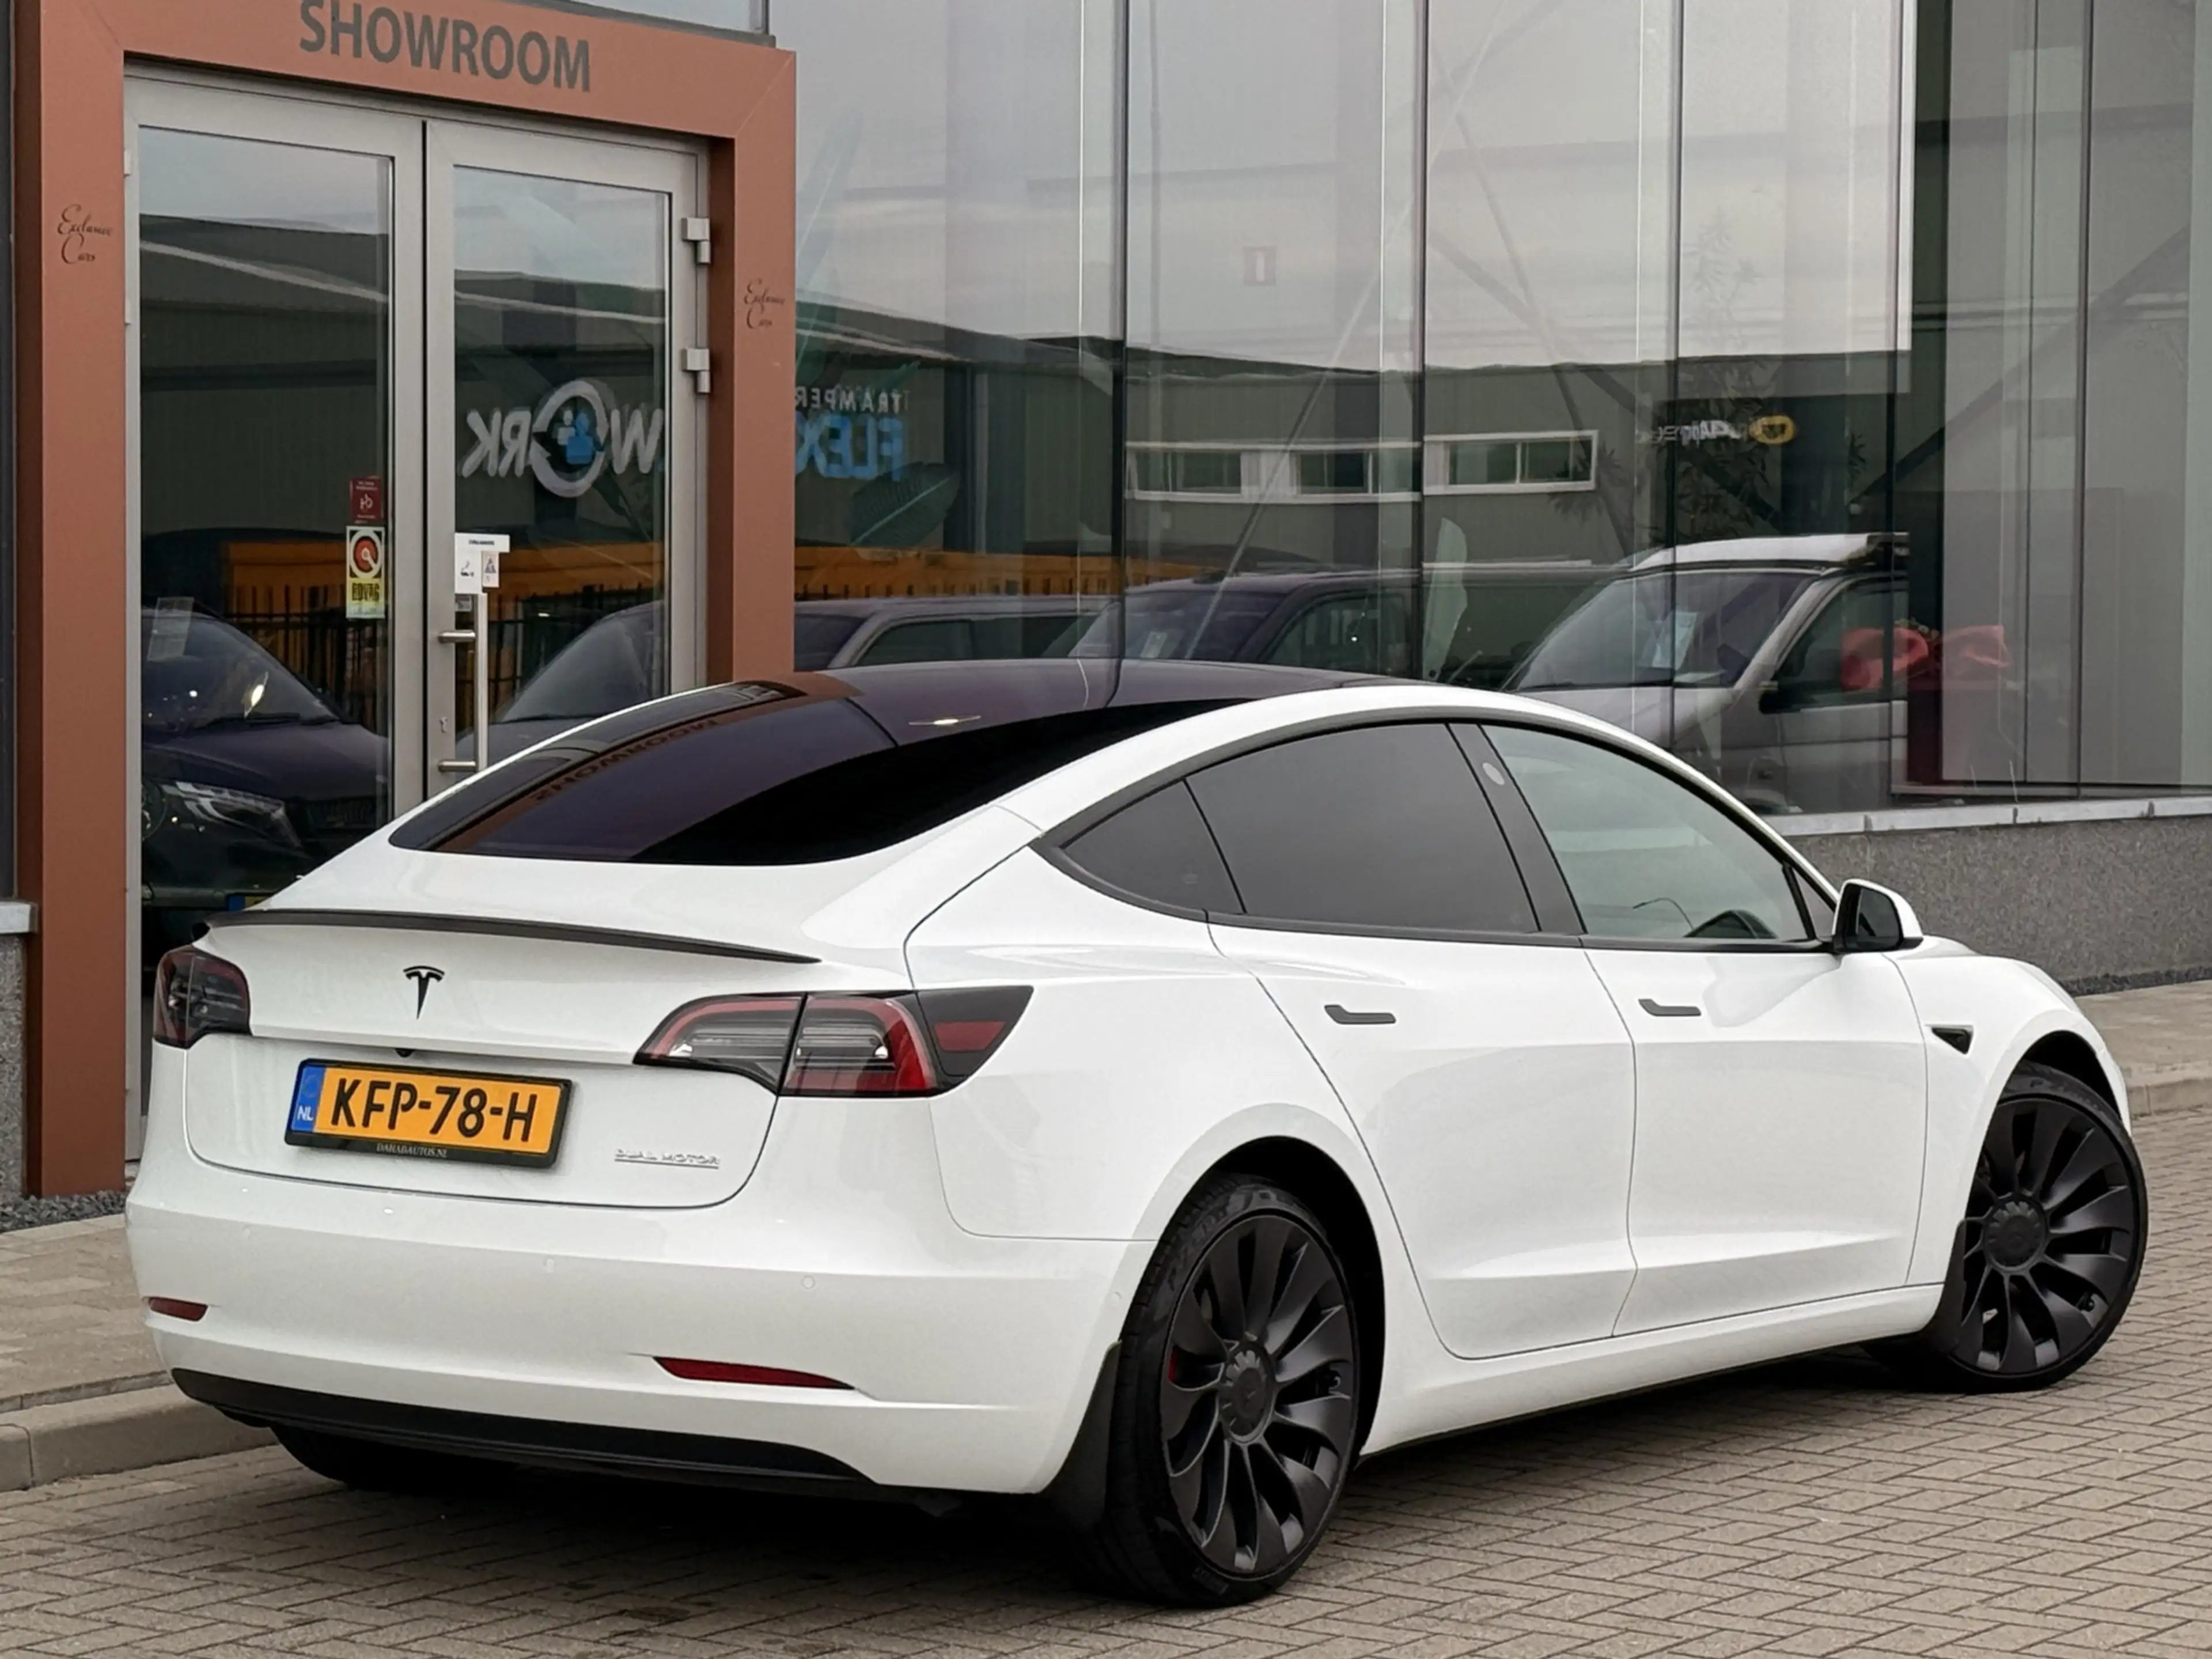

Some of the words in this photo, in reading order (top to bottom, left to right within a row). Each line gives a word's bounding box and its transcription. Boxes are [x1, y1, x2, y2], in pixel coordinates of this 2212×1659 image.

[299, 0, 590, 93] SHOWROOM
[297, 1104, 314, 1121] NL
[331, 1077, 538, 1143] KFP-78-H
[614, 1149, 658, 1161] DUAL
[661, 1153, 719, 1165] MOTOR
